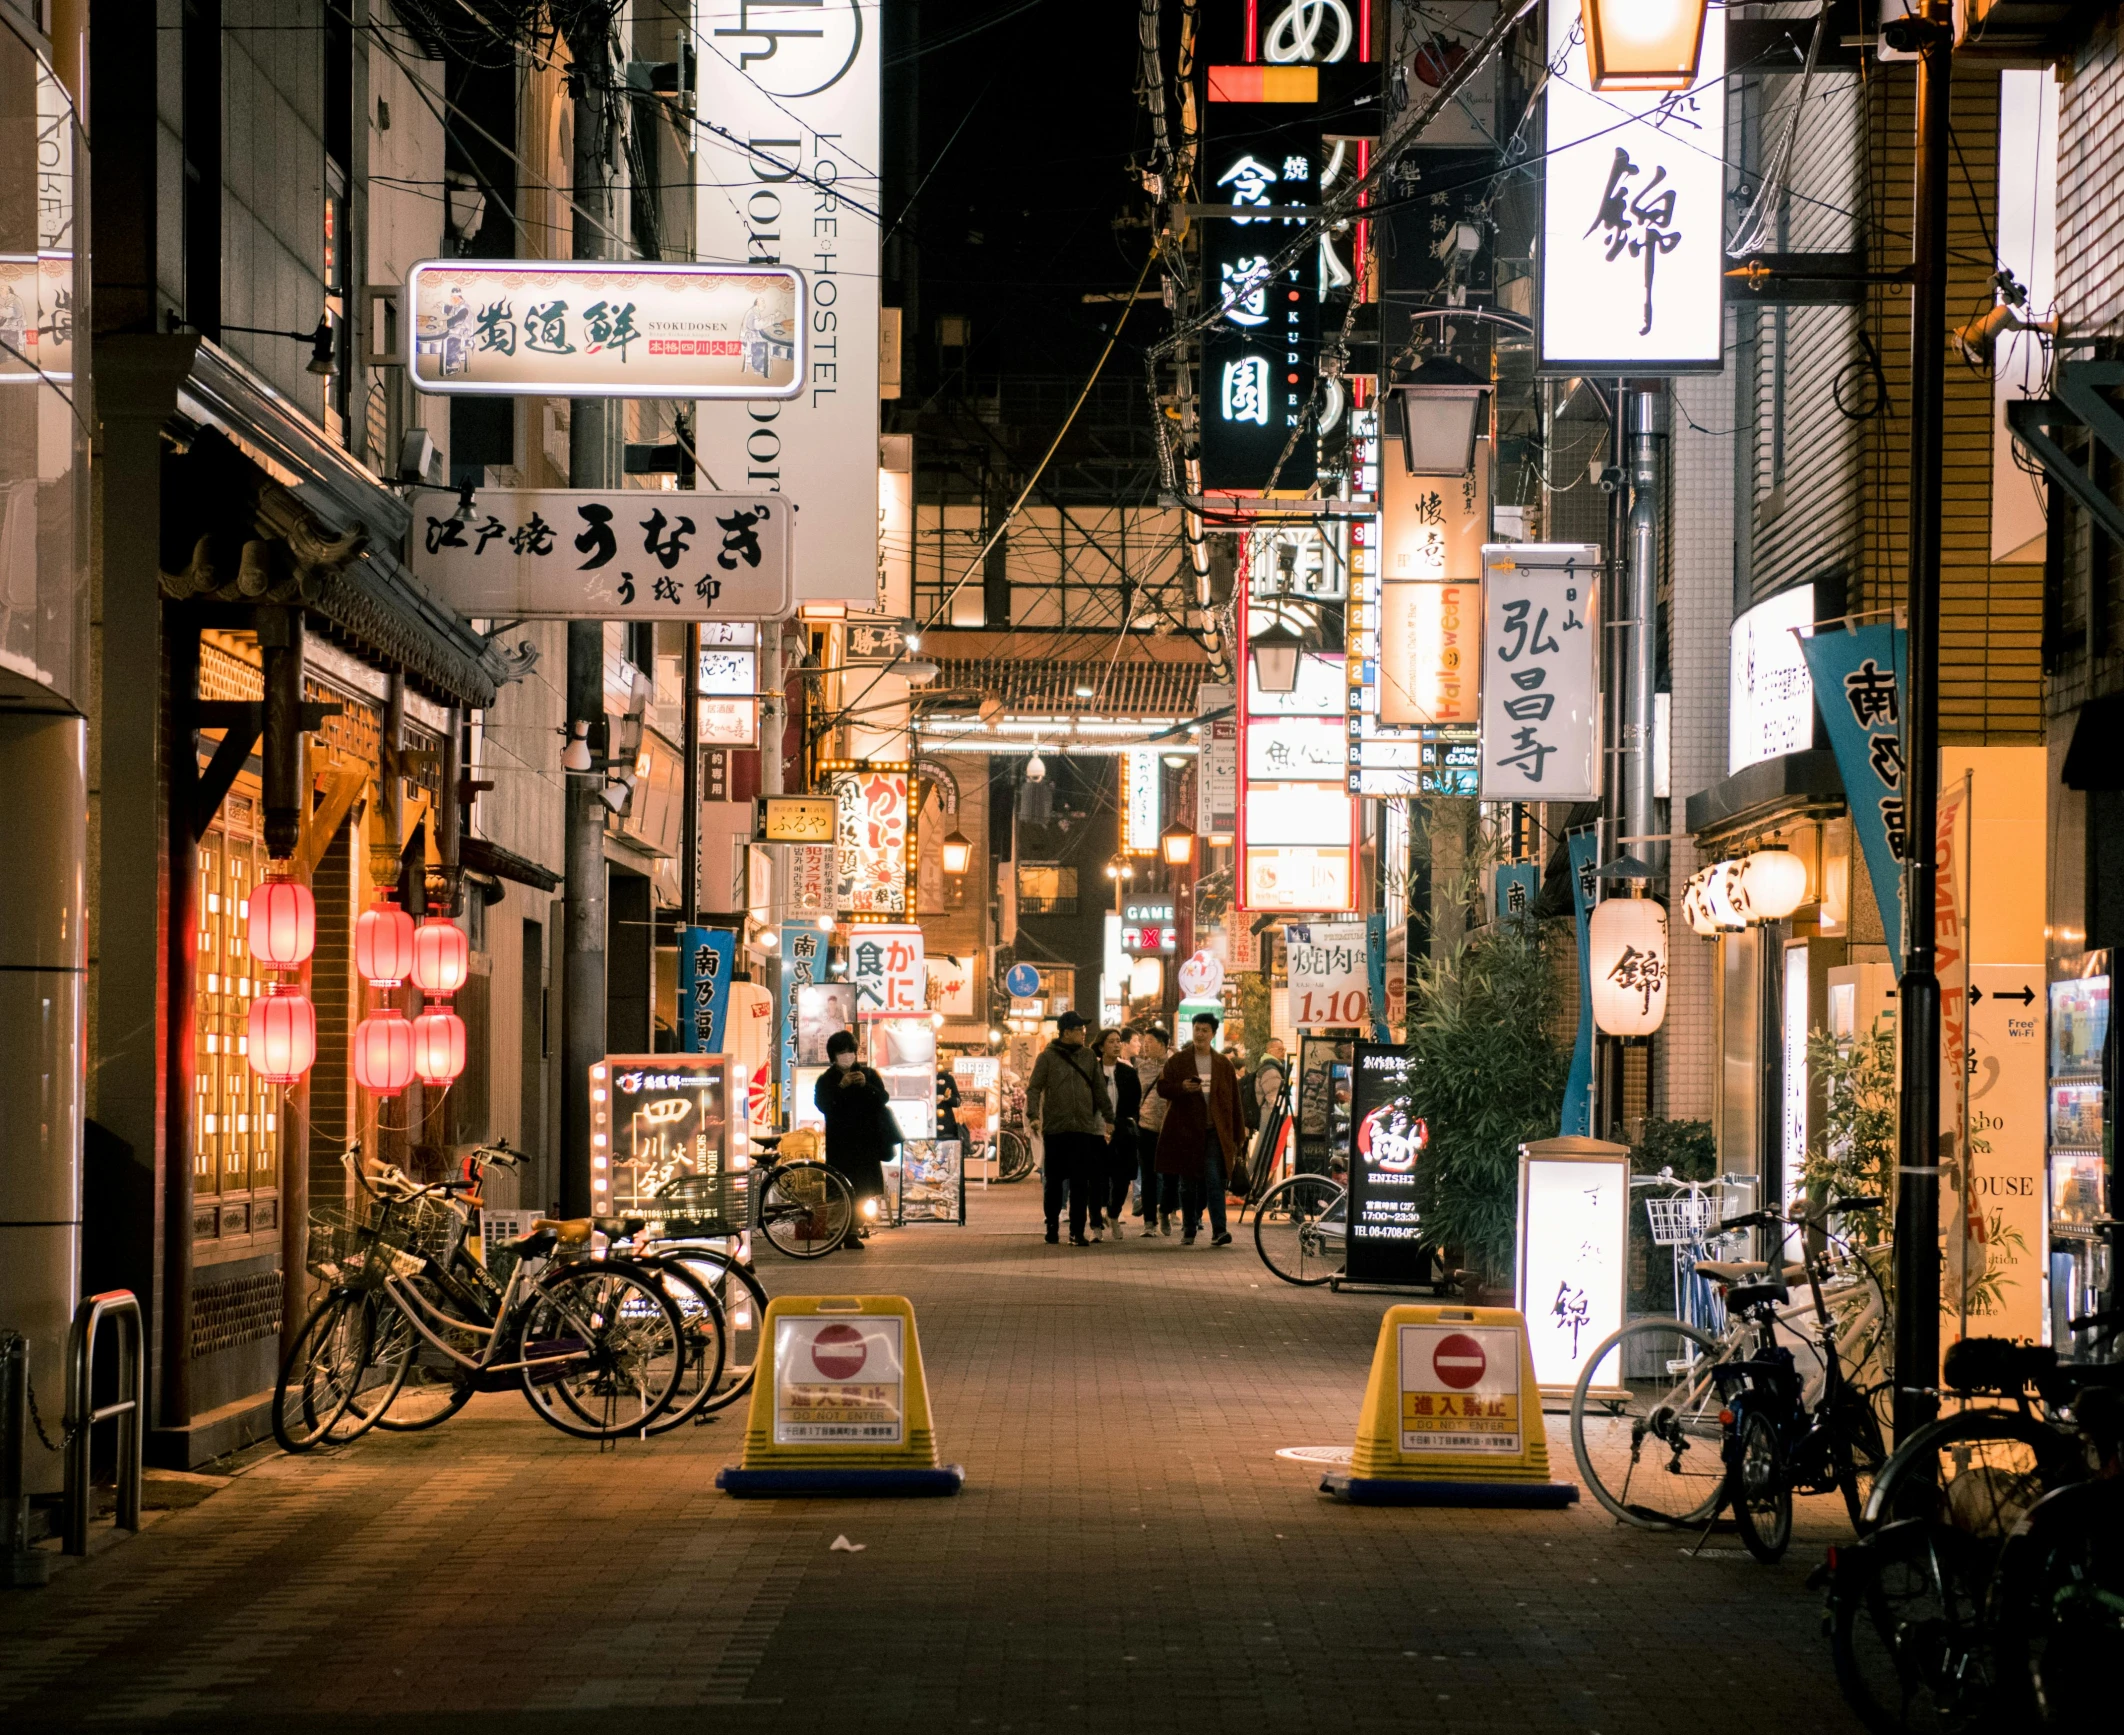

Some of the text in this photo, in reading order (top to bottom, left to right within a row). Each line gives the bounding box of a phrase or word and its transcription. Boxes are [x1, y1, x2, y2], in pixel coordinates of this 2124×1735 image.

[1583, 147, 1682, 337] 錦
[813, 134, 842, 408] LORE HOSTEL
[1217, 156, 1278, 426] 食道園
[475, 295, 642, 364] 蜀道鮮
[649, 322, 728, 331] SYOKUDOSEN
[574, 503, 771, 571] うなぎ
[1562, 557, 1583, 631] 千日山
[850, 626, 902, 655] 勝牛
[1496, 599, 1560, 783] 弘昌寺
[707, 704, 735, 714] 居酒屋
[1204, 725, 1212, 736] 3
[1204, 744, 1212, 754] 2
[711, 753, 722, 794] 約専用
[773, 815, 827, 834] ふるや
[864, 774, 906, 849] かに
[1506, 880, 1526, 912] 南
[1127, 906, 1173, 919] GAME
[854, 940, 885, 1007] 食べ
[886, 940, 916, 1007] かに
[1607, 945, 1661, 1016] 錦
[694, 944, 721, 1053] 南乃福
[2008, 1019, 2034, 1029] Free
[2009, 1028, 2035, 1038] Wi-Fi
[696, 1134, 706, 1173] SICHUAN
[1368, 1173, 1415, 1184] ENISHI
[1974, 1176, 2034, 1196] OUSE
[1366, 1201, 1398, 1211] 営業時間
[1354, 1226, 1367, 1236] TEL
[475, 1267, 497, 1290] ange
[1551, 1281, 1590, 1360] 錦
[793, 1411, 884, 1420] DO NOT ENTER
[1414, 1396, 1507, 1417] 進入禁止
[1416, 1420, 1504, 1430] DO NOT ENTER
